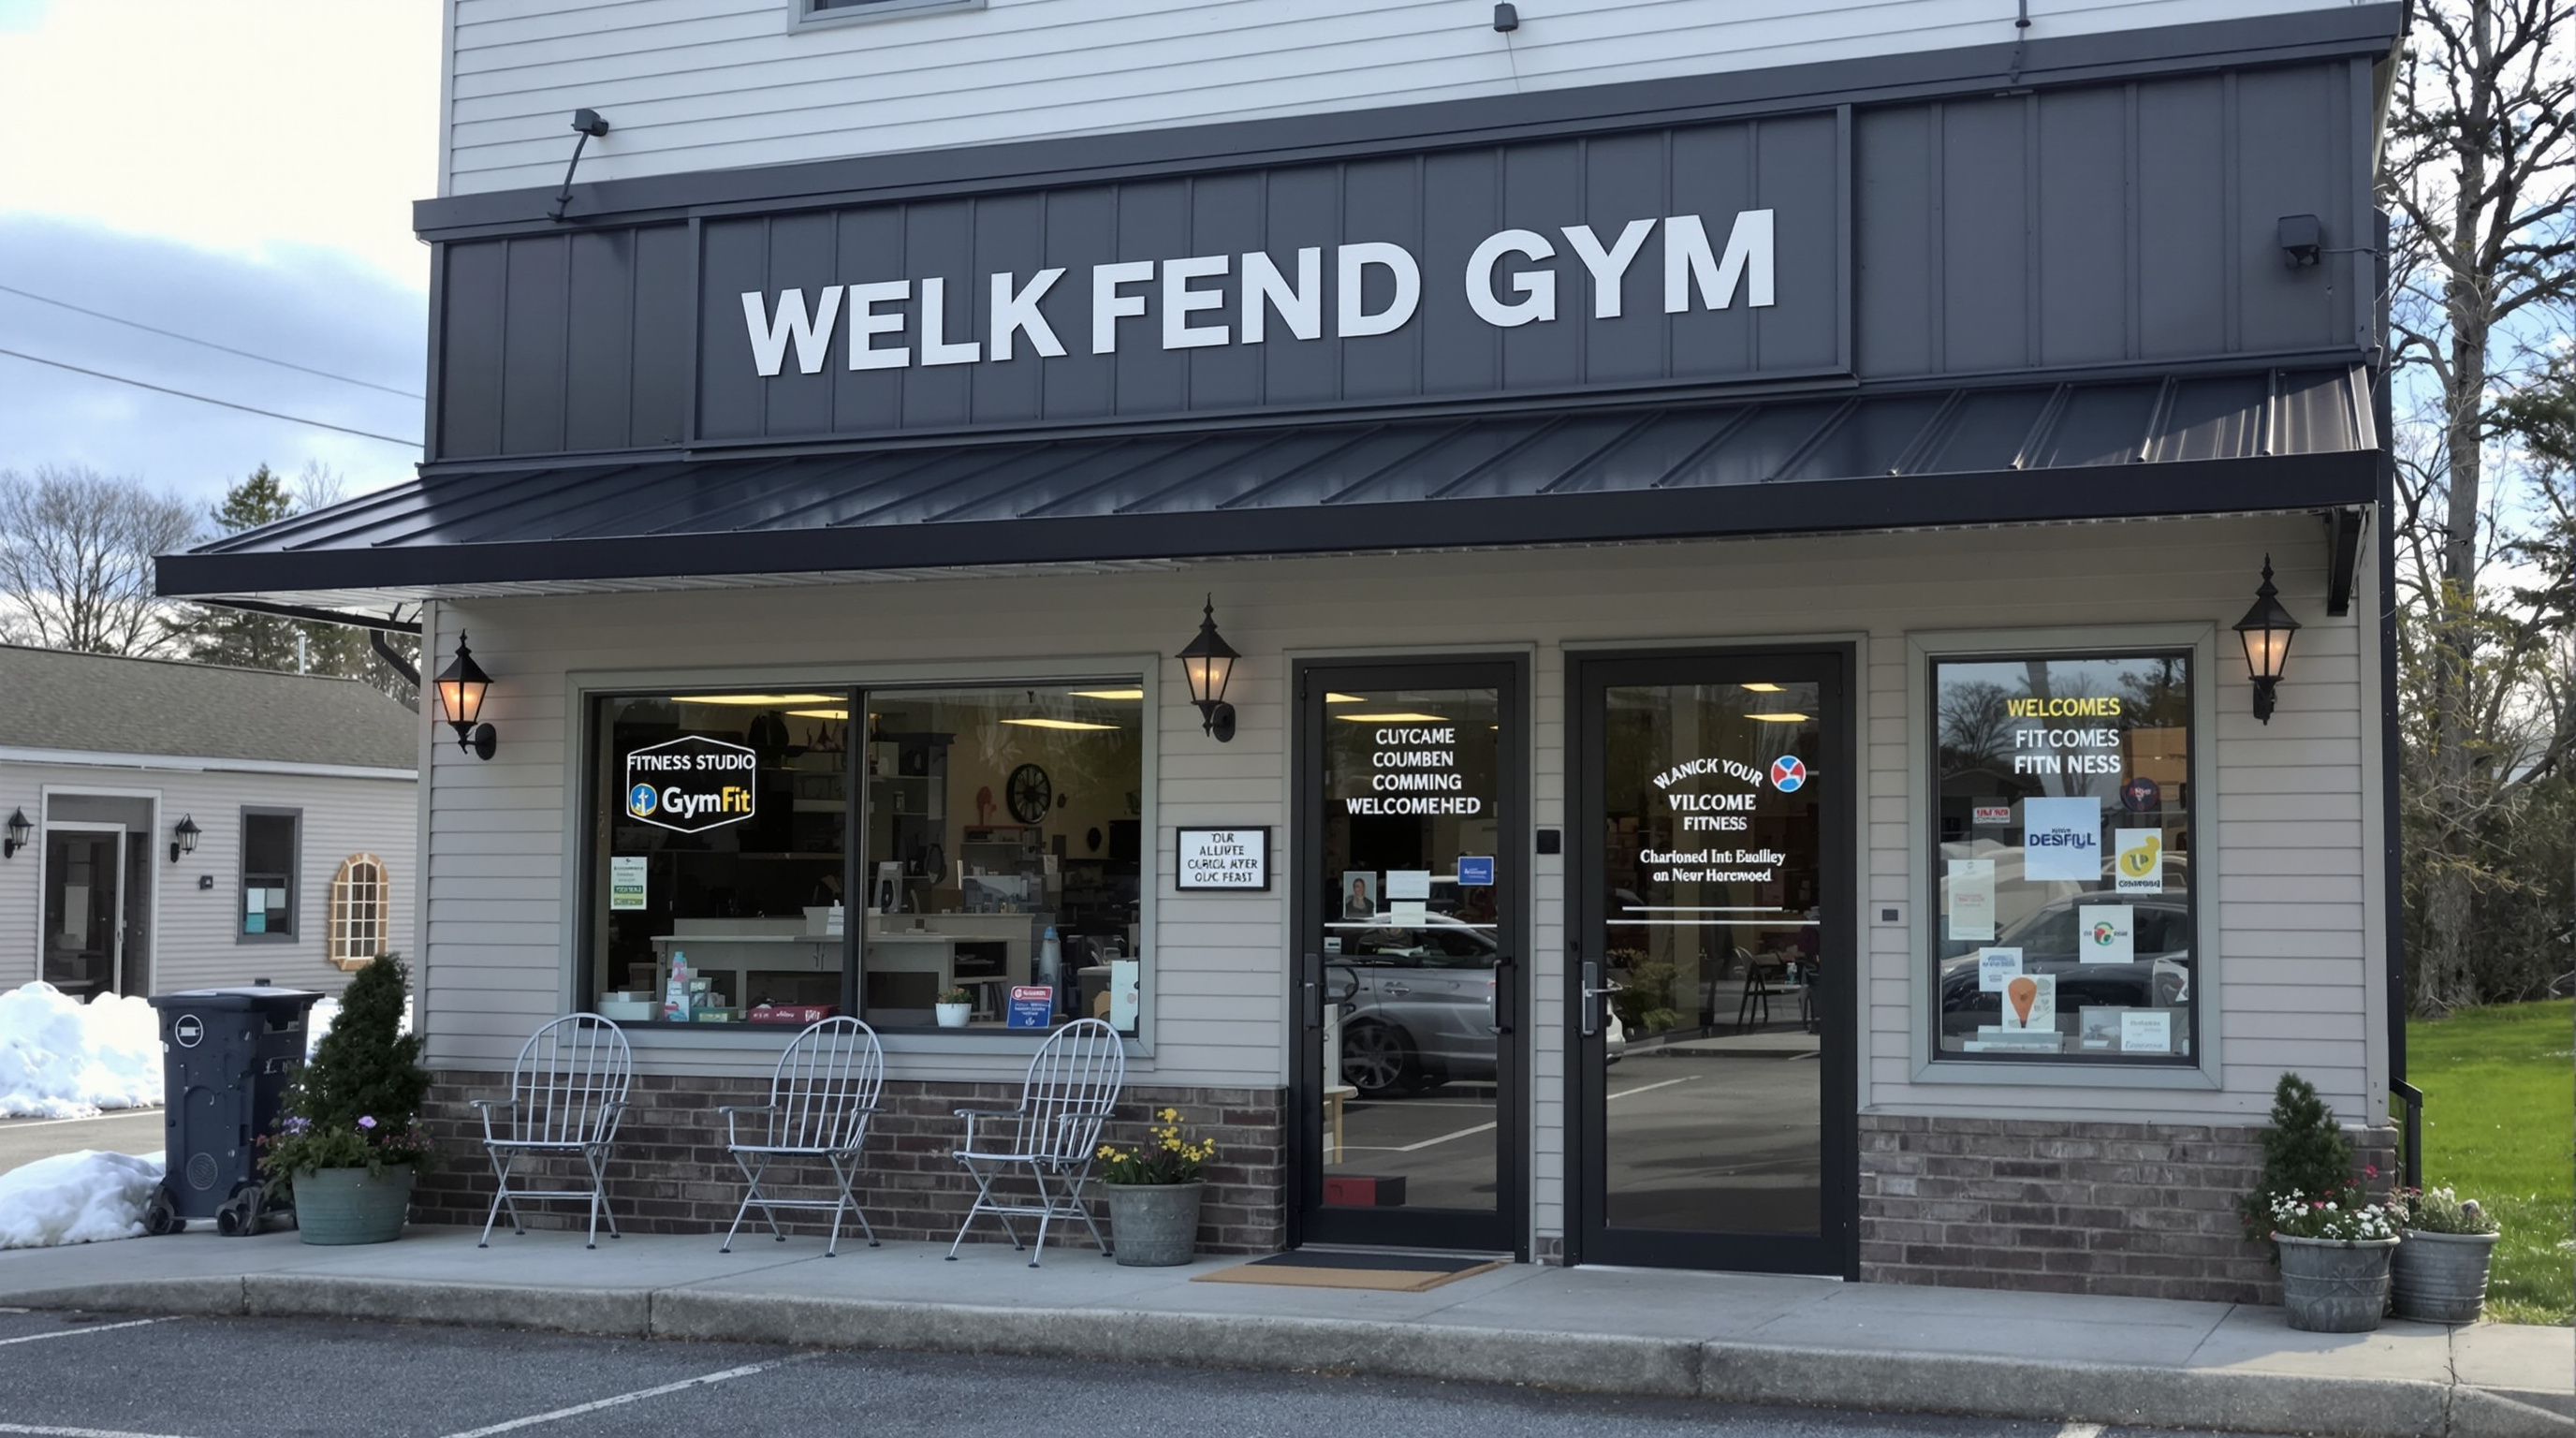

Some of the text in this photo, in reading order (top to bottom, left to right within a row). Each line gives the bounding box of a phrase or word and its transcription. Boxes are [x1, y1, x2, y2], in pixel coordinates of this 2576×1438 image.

[740, 208, 1775, 377] WELK FEND GYM
[2007, 697, 2121, 717] WELCOMES
[1375, 727, 1456, 745] CUYCAME
[628, 754, 756, 770] FITNESS STUDIO
[1372, 751, 1454, 768] COUMBEN
[1372, 773, 1462, 790] COMMING
[1721, 759, 1764, 787] YOUR
[662, 786, 751, 819] GymFit
[1346, 798, 1481, 814] WELCOMEHED
[1668, 794, 1757, 811] VILCOME
[1683, 816, 1748, 831] FITNESS
